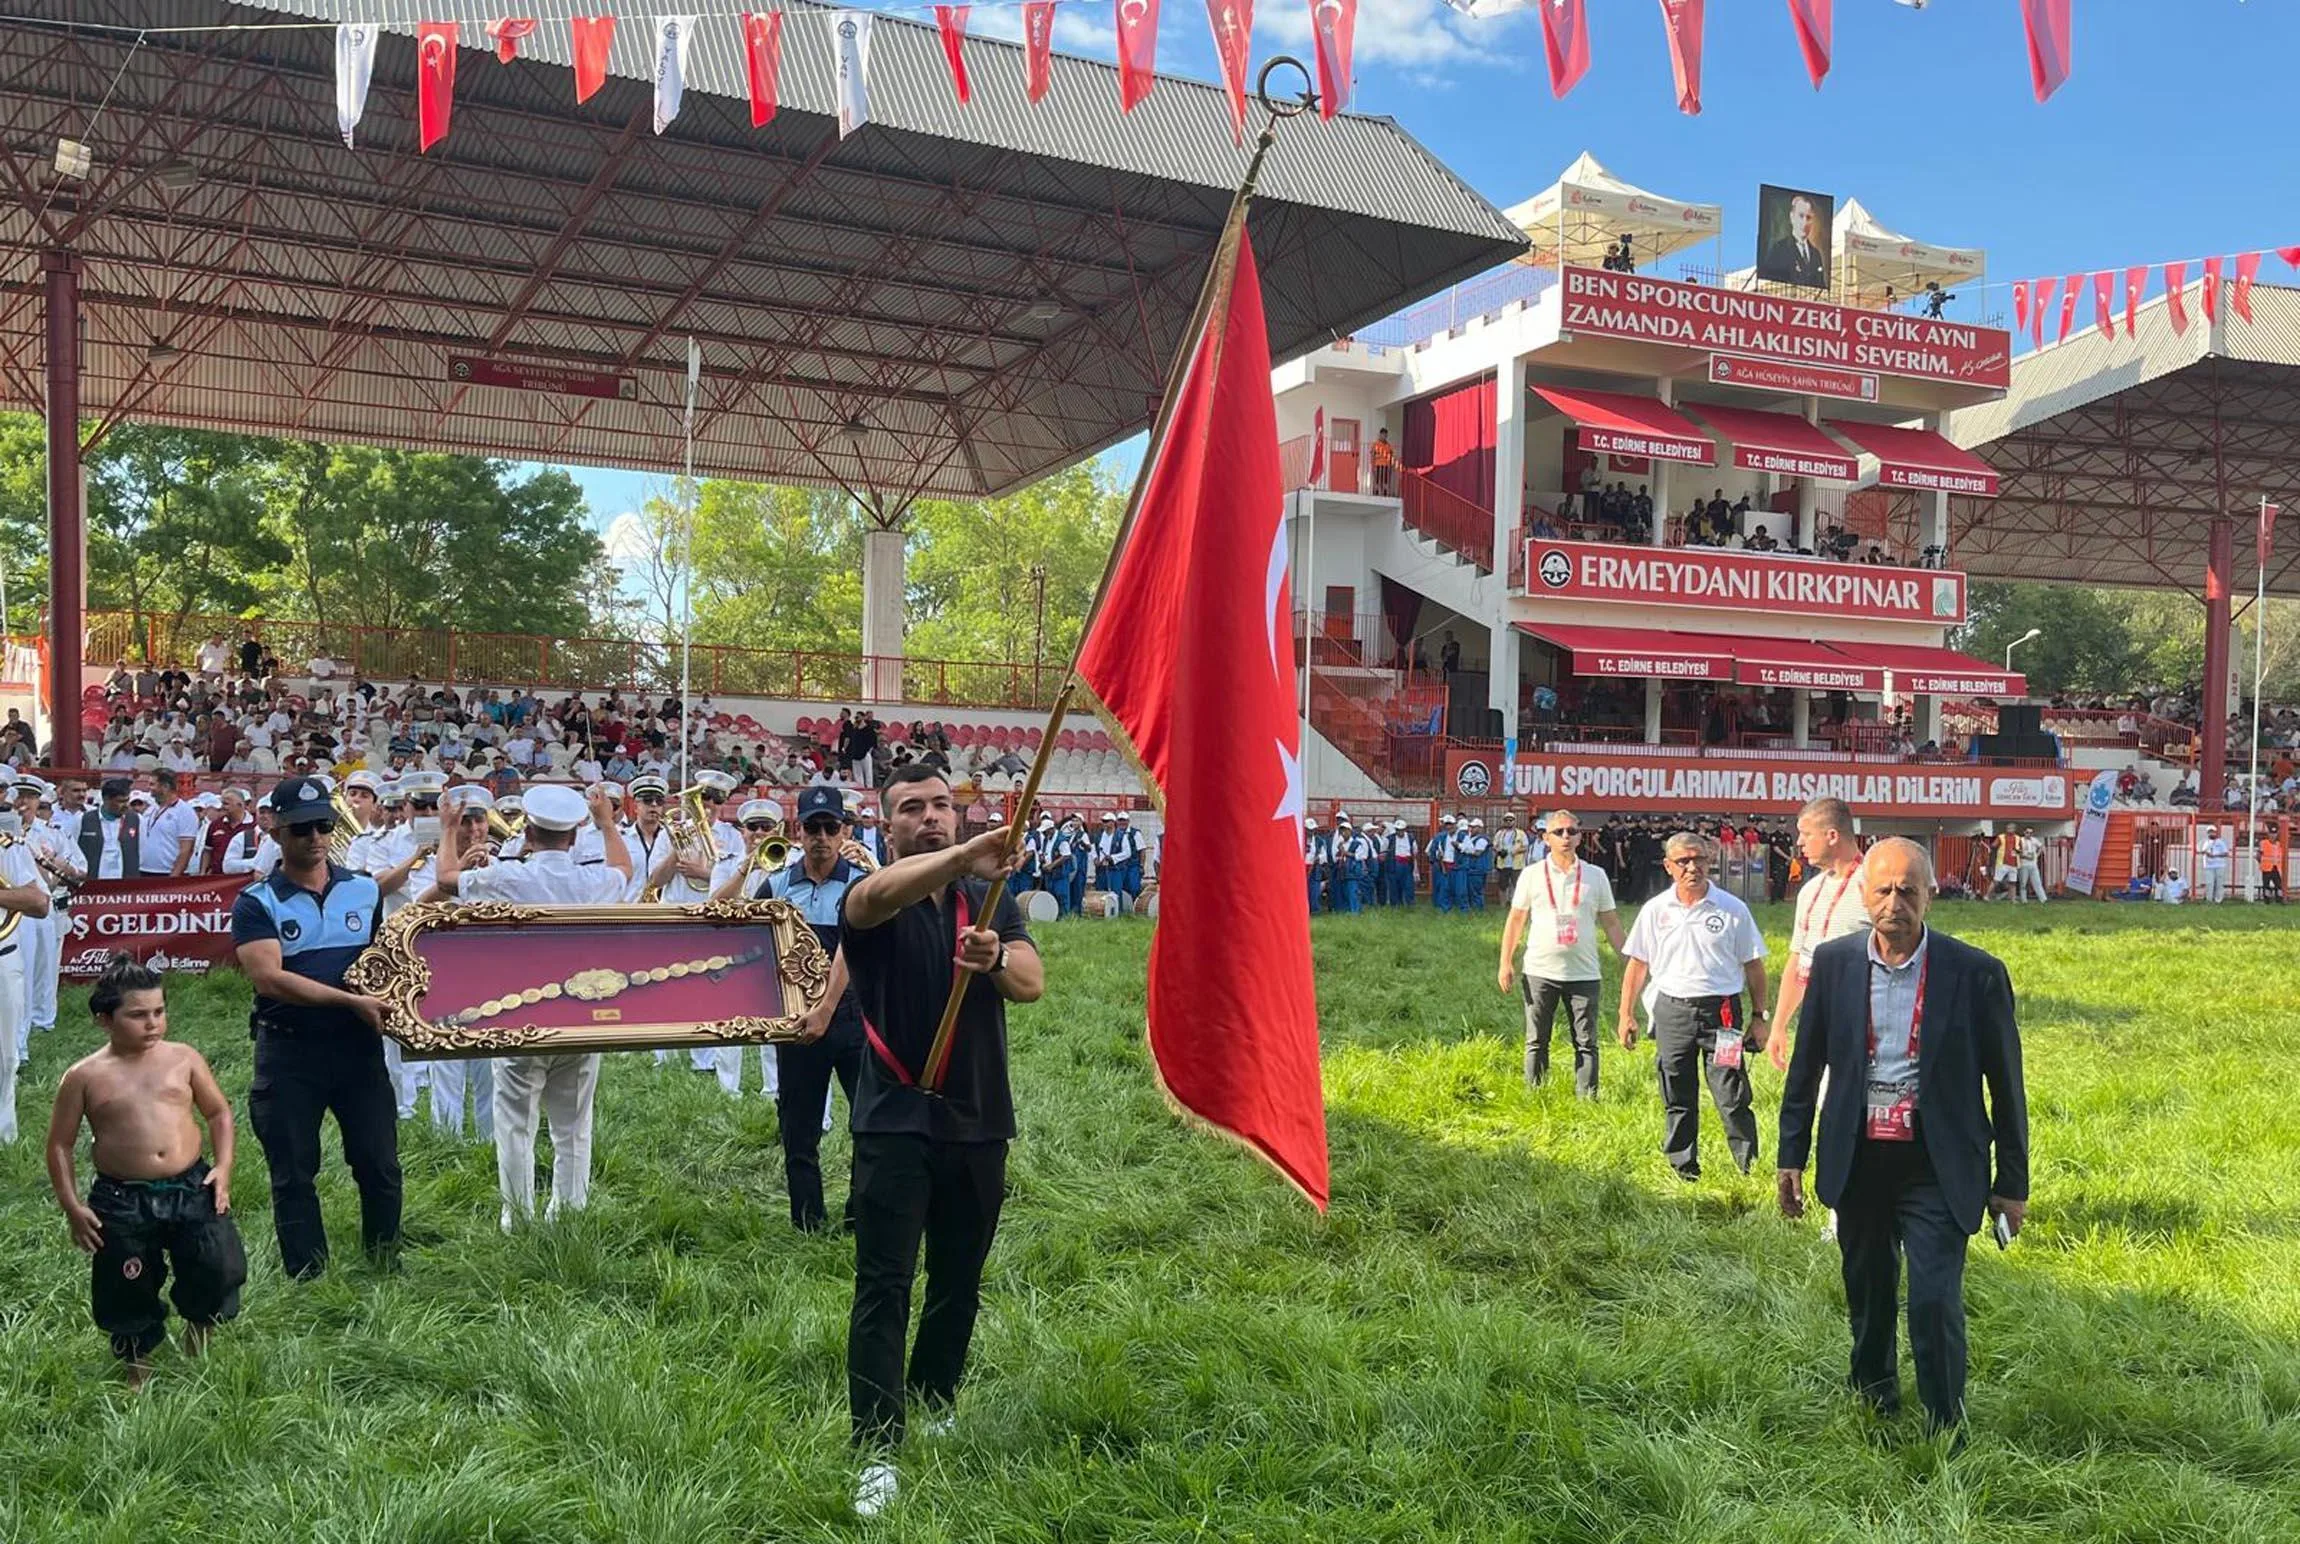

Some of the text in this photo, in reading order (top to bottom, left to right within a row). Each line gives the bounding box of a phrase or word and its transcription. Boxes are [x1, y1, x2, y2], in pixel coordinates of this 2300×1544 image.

[1569, 273, 1976, 350] BEN SPORCUNUN ZEKİ, ÇEVİK AYNI
[1567, 303, 1696, 340] ZAMANDA
[1701, 323, 1849, 361] AHLAKLISINI
[1855, 344, 1955, 375] SEVERİM.
[1592, 434, 1702, 459] T.C. EDİRNE BELEDİYESİ
[1747, 453, 1847, 477] T.C. EDİRNE BELEDİYESİ
[1891, 470, 1986, 492] T.C. EDİRNE BELEDİYESİ
[1580, 555, 1921, 610] ERMEYDANI KIRKPINAR
[1599, 657, 1709, 675] T.C. EDİRNE BELEDİYESİ
[1760, 668, 1864, 687] T.C. EDİRNE BELEDİYESİ
[1912, 677, 2006, 694] T.C. EDİRNE BELEDİYESİ
[1560, 766, 1768, 800] SPORCULARIMIZA
[136, 890, 222, 904] KIRKPINAR'A
[96, 908, 233, 935] GELDİNİZ
[171, 956, 210, 968] Edirne
